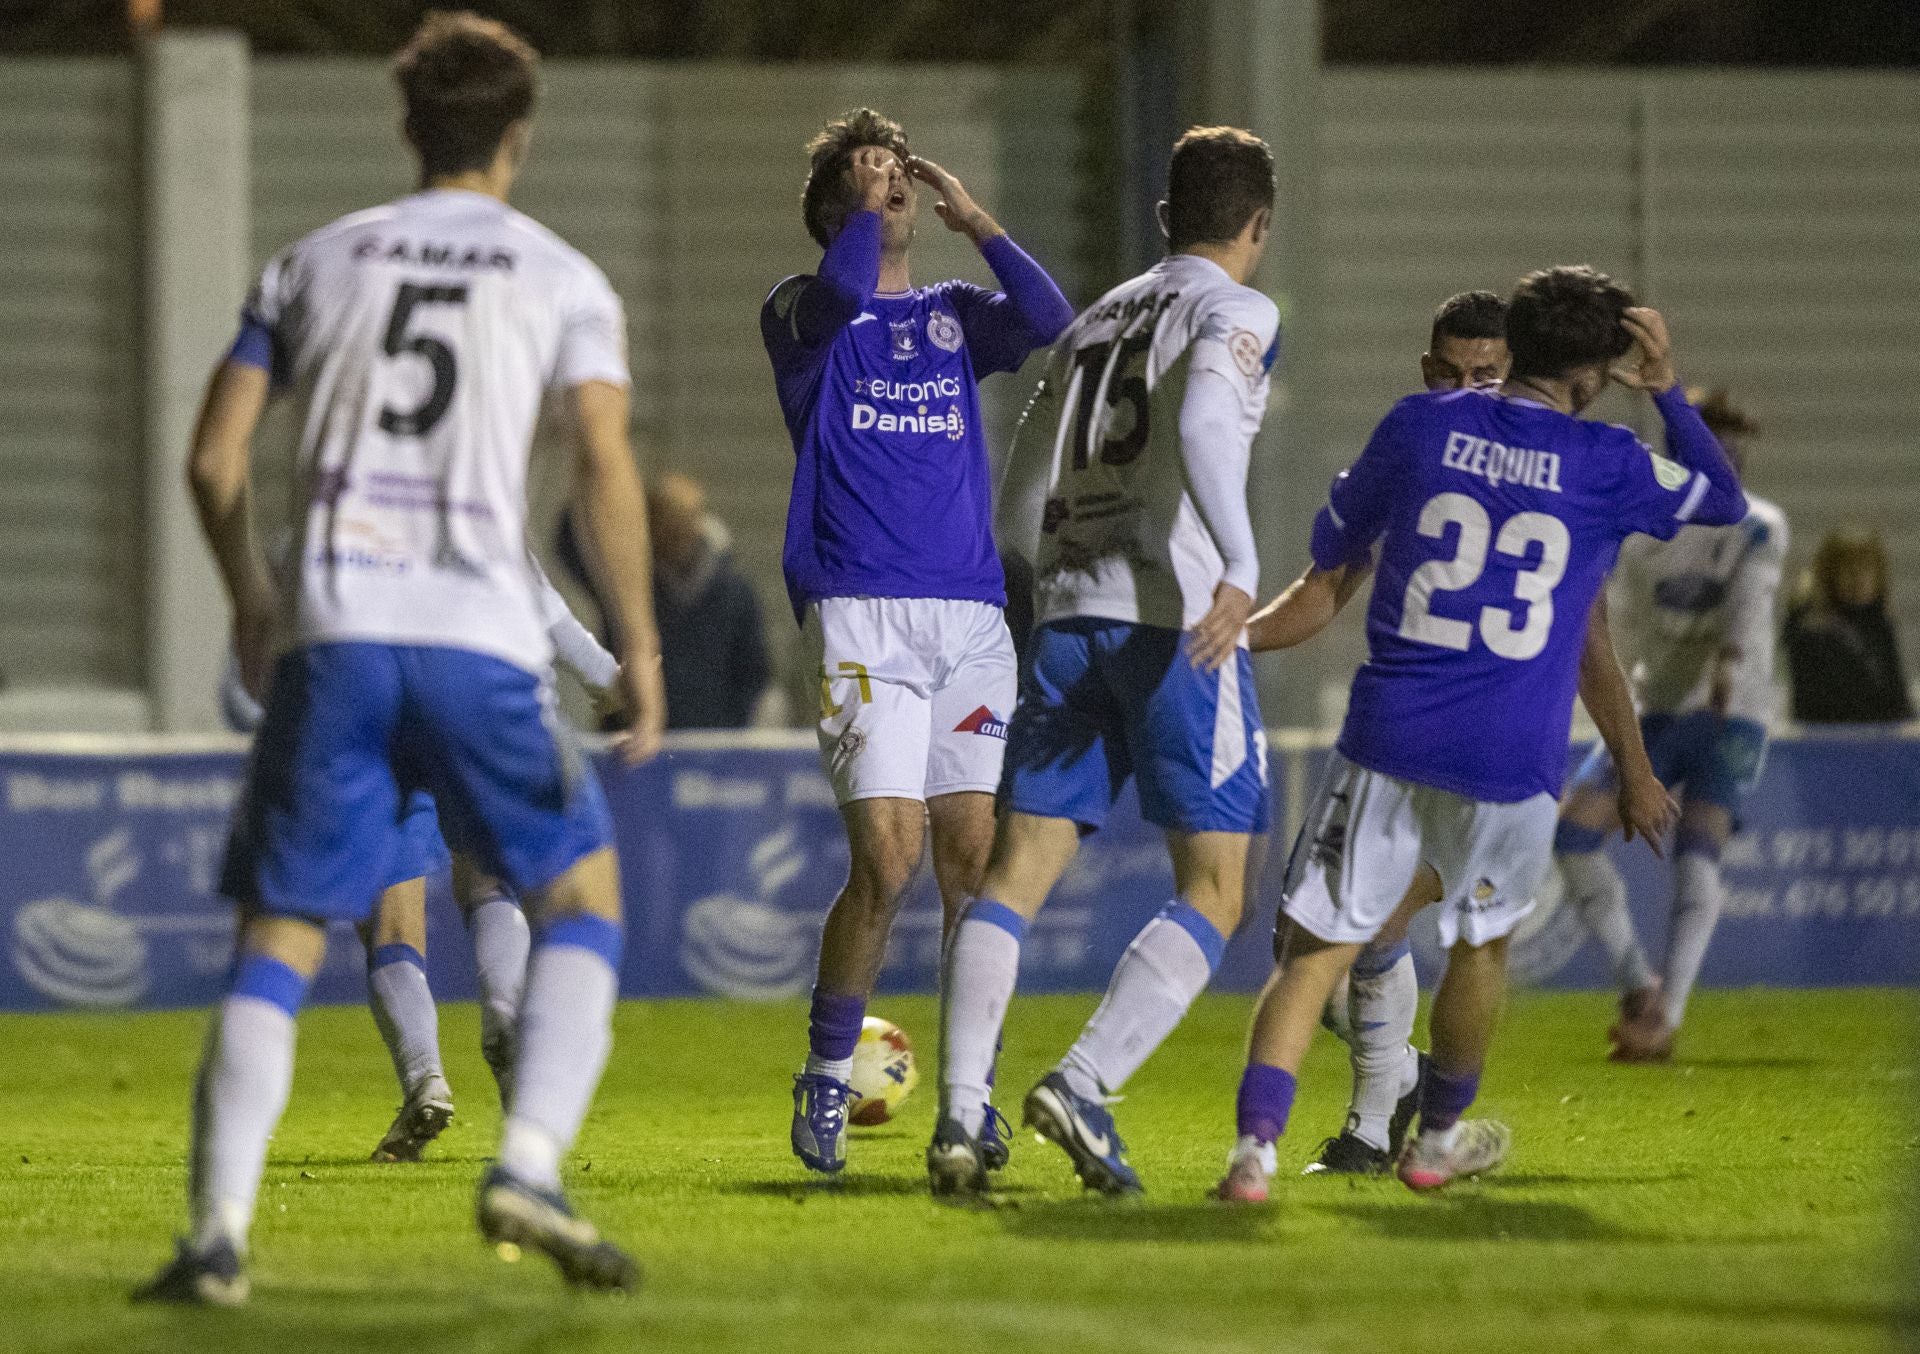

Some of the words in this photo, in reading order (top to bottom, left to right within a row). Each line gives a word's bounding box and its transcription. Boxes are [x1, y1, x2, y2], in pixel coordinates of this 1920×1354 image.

[378, 280, 469, 437] 5
[1072, 330, 1150, 468] 15
[852, 404, 962, 435] Danisa
[1441, 430, 1562, 494] EZEQUIEL
[1400, 491, 1571, 661] 23
[980, 722, 1008, 740] ant
